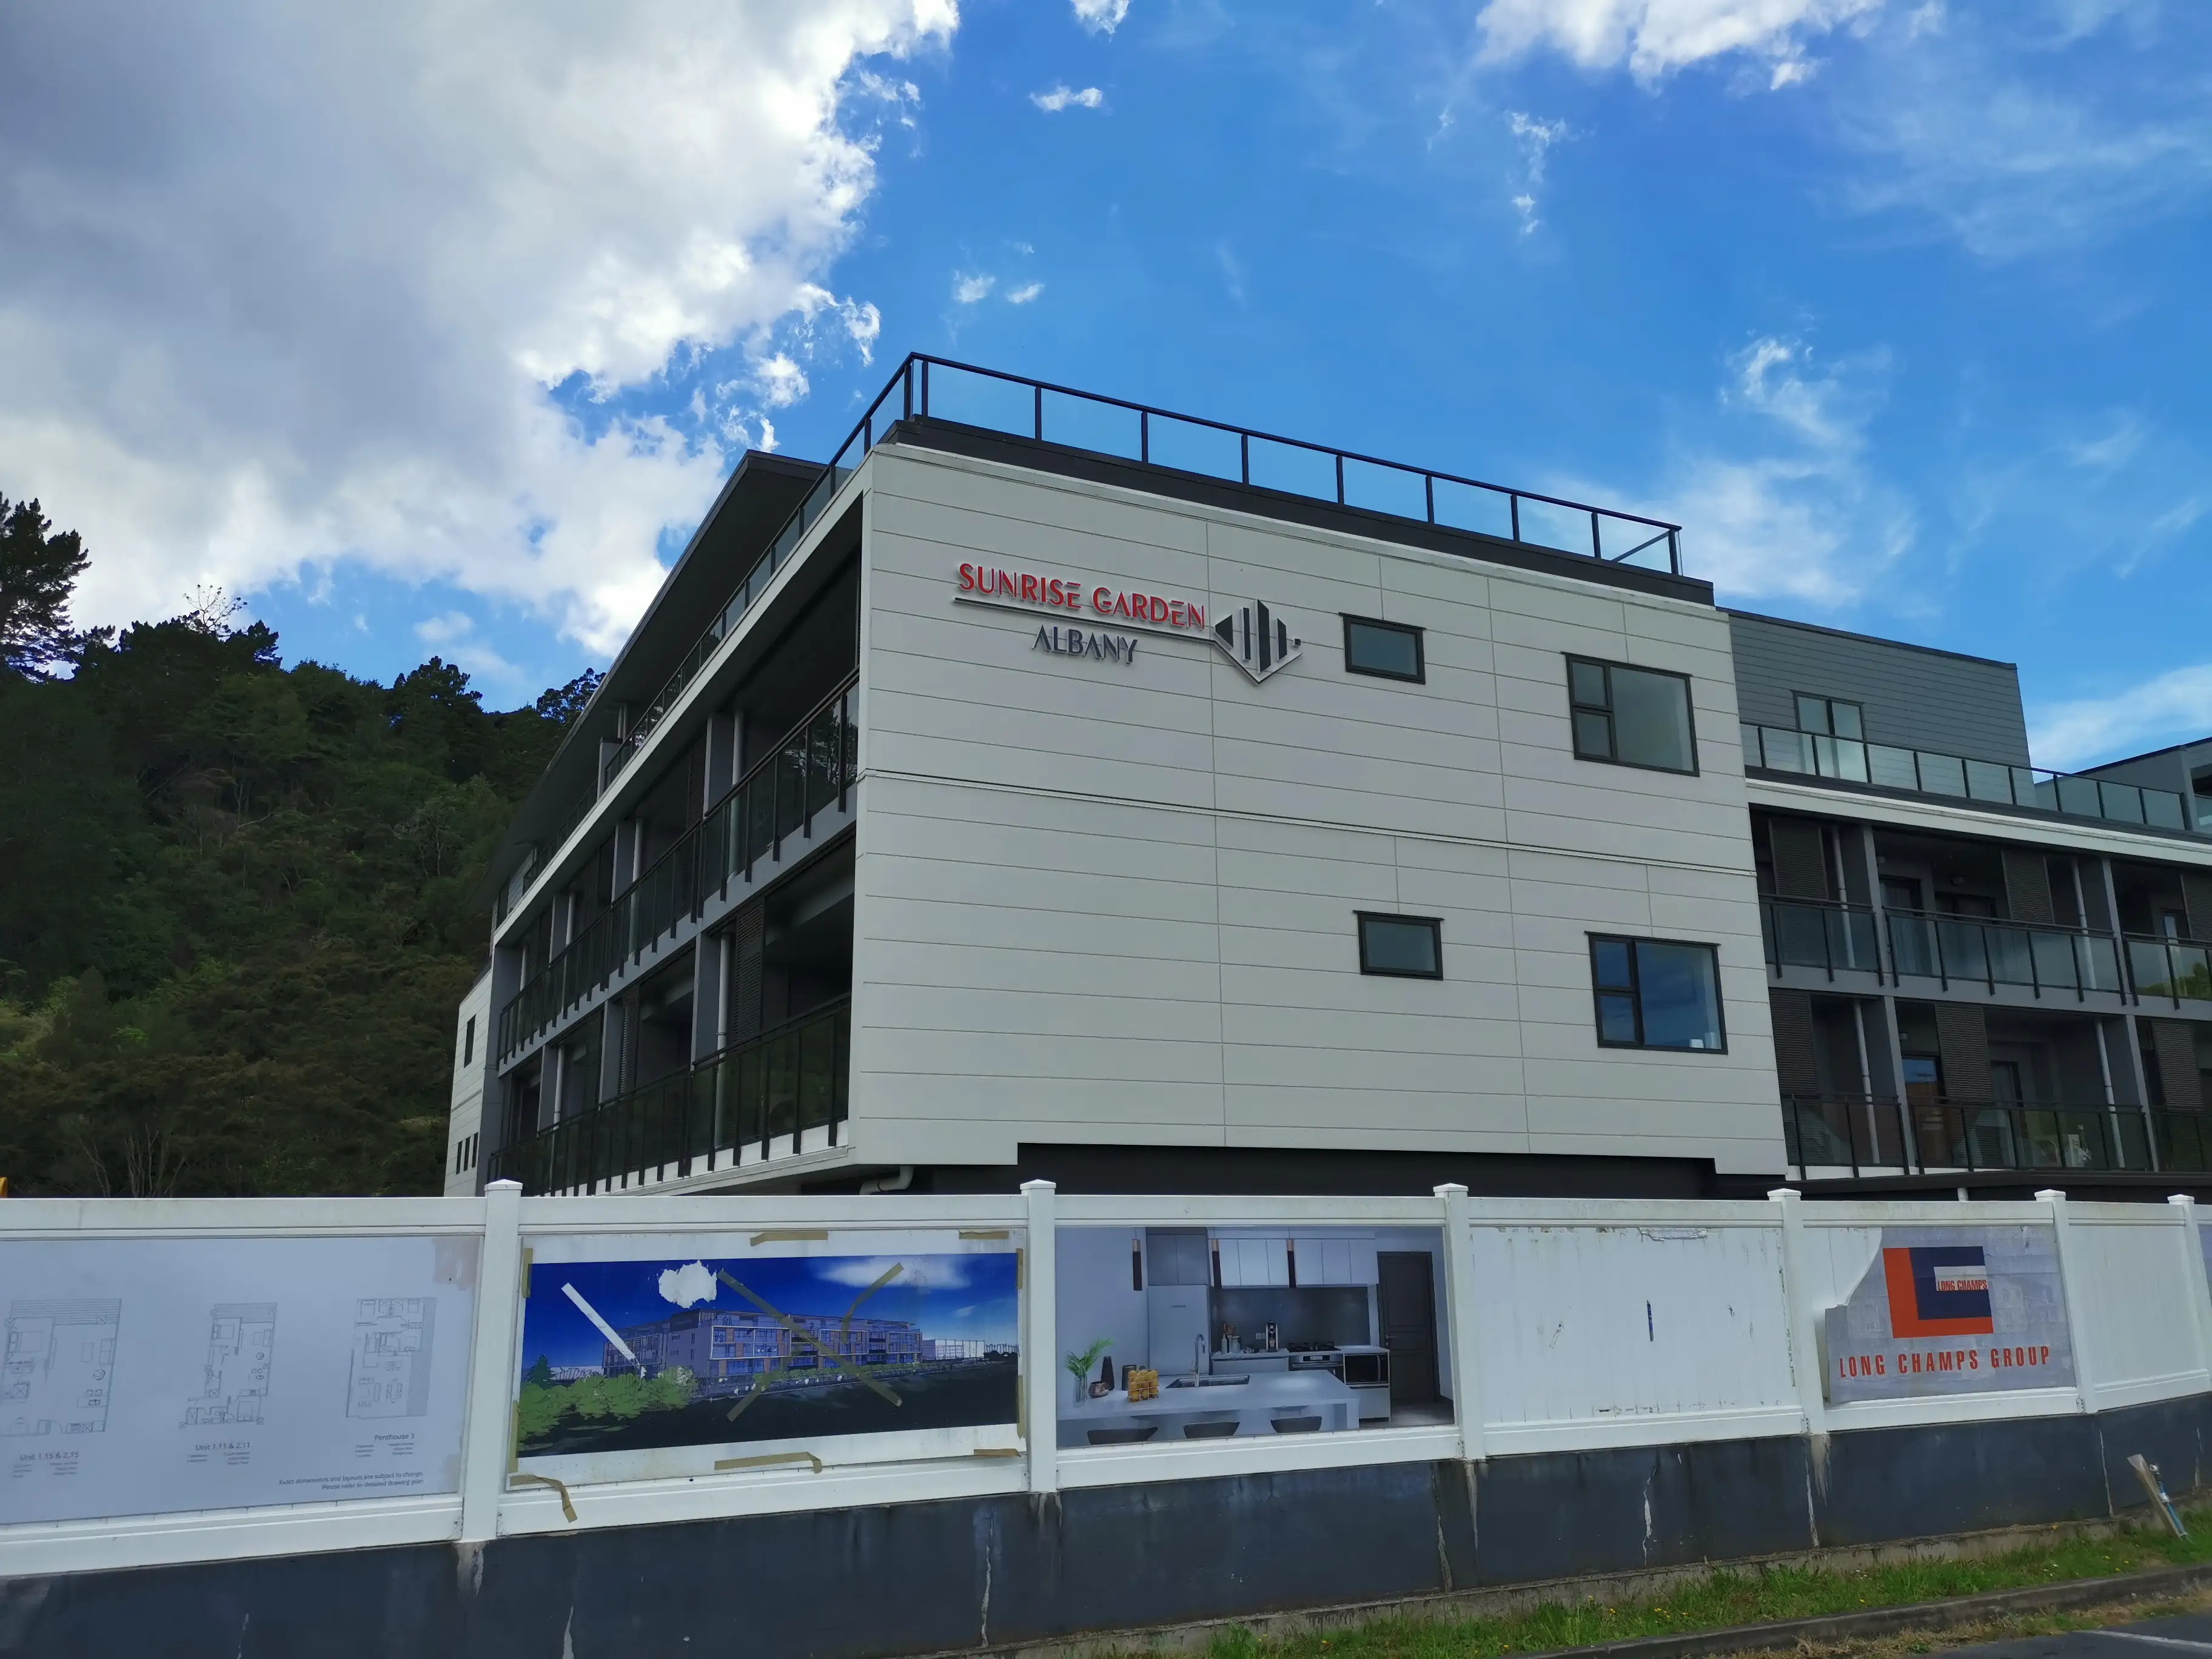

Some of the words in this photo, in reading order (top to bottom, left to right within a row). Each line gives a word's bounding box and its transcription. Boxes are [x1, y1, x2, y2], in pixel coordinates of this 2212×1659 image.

[958, 563, 1081, 609] SUNRISE
[1093, 587, 1205, 631] GARDEN
[1031, 624, 1138, 665] ALBANY
[1937, 1279, 1956, 1292] LONG
[1957, 1278, 1988, 1291] CHAMPS
[1839, 1354, 1885, 1378] LONG
[1898, 1349, 1979, 1374] CHAMPS
[1990, 1346, 2049, 1369] GROUP
